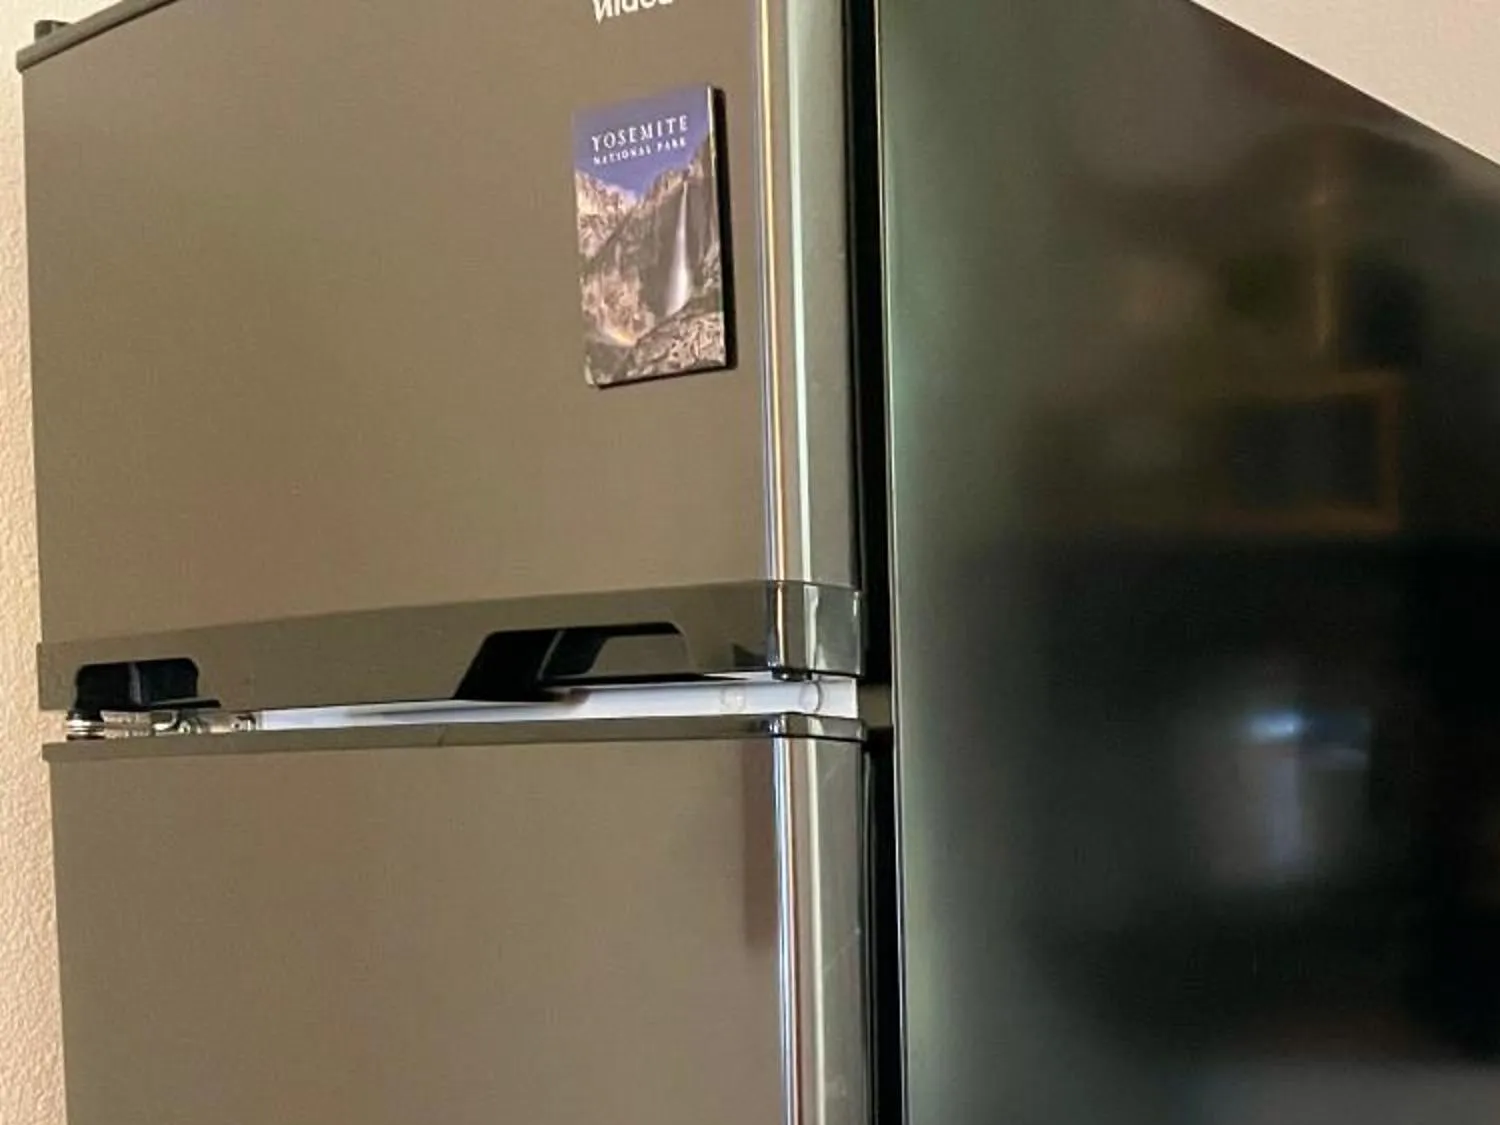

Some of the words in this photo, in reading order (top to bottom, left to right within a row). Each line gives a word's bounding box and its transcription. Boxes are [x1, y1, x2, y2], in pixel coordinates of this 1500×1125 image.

[592, 114, 688, 152] YOSEMITE
[593, 144, 652, 165] NATIONAL
[657, 136, 686, 152] PARK
